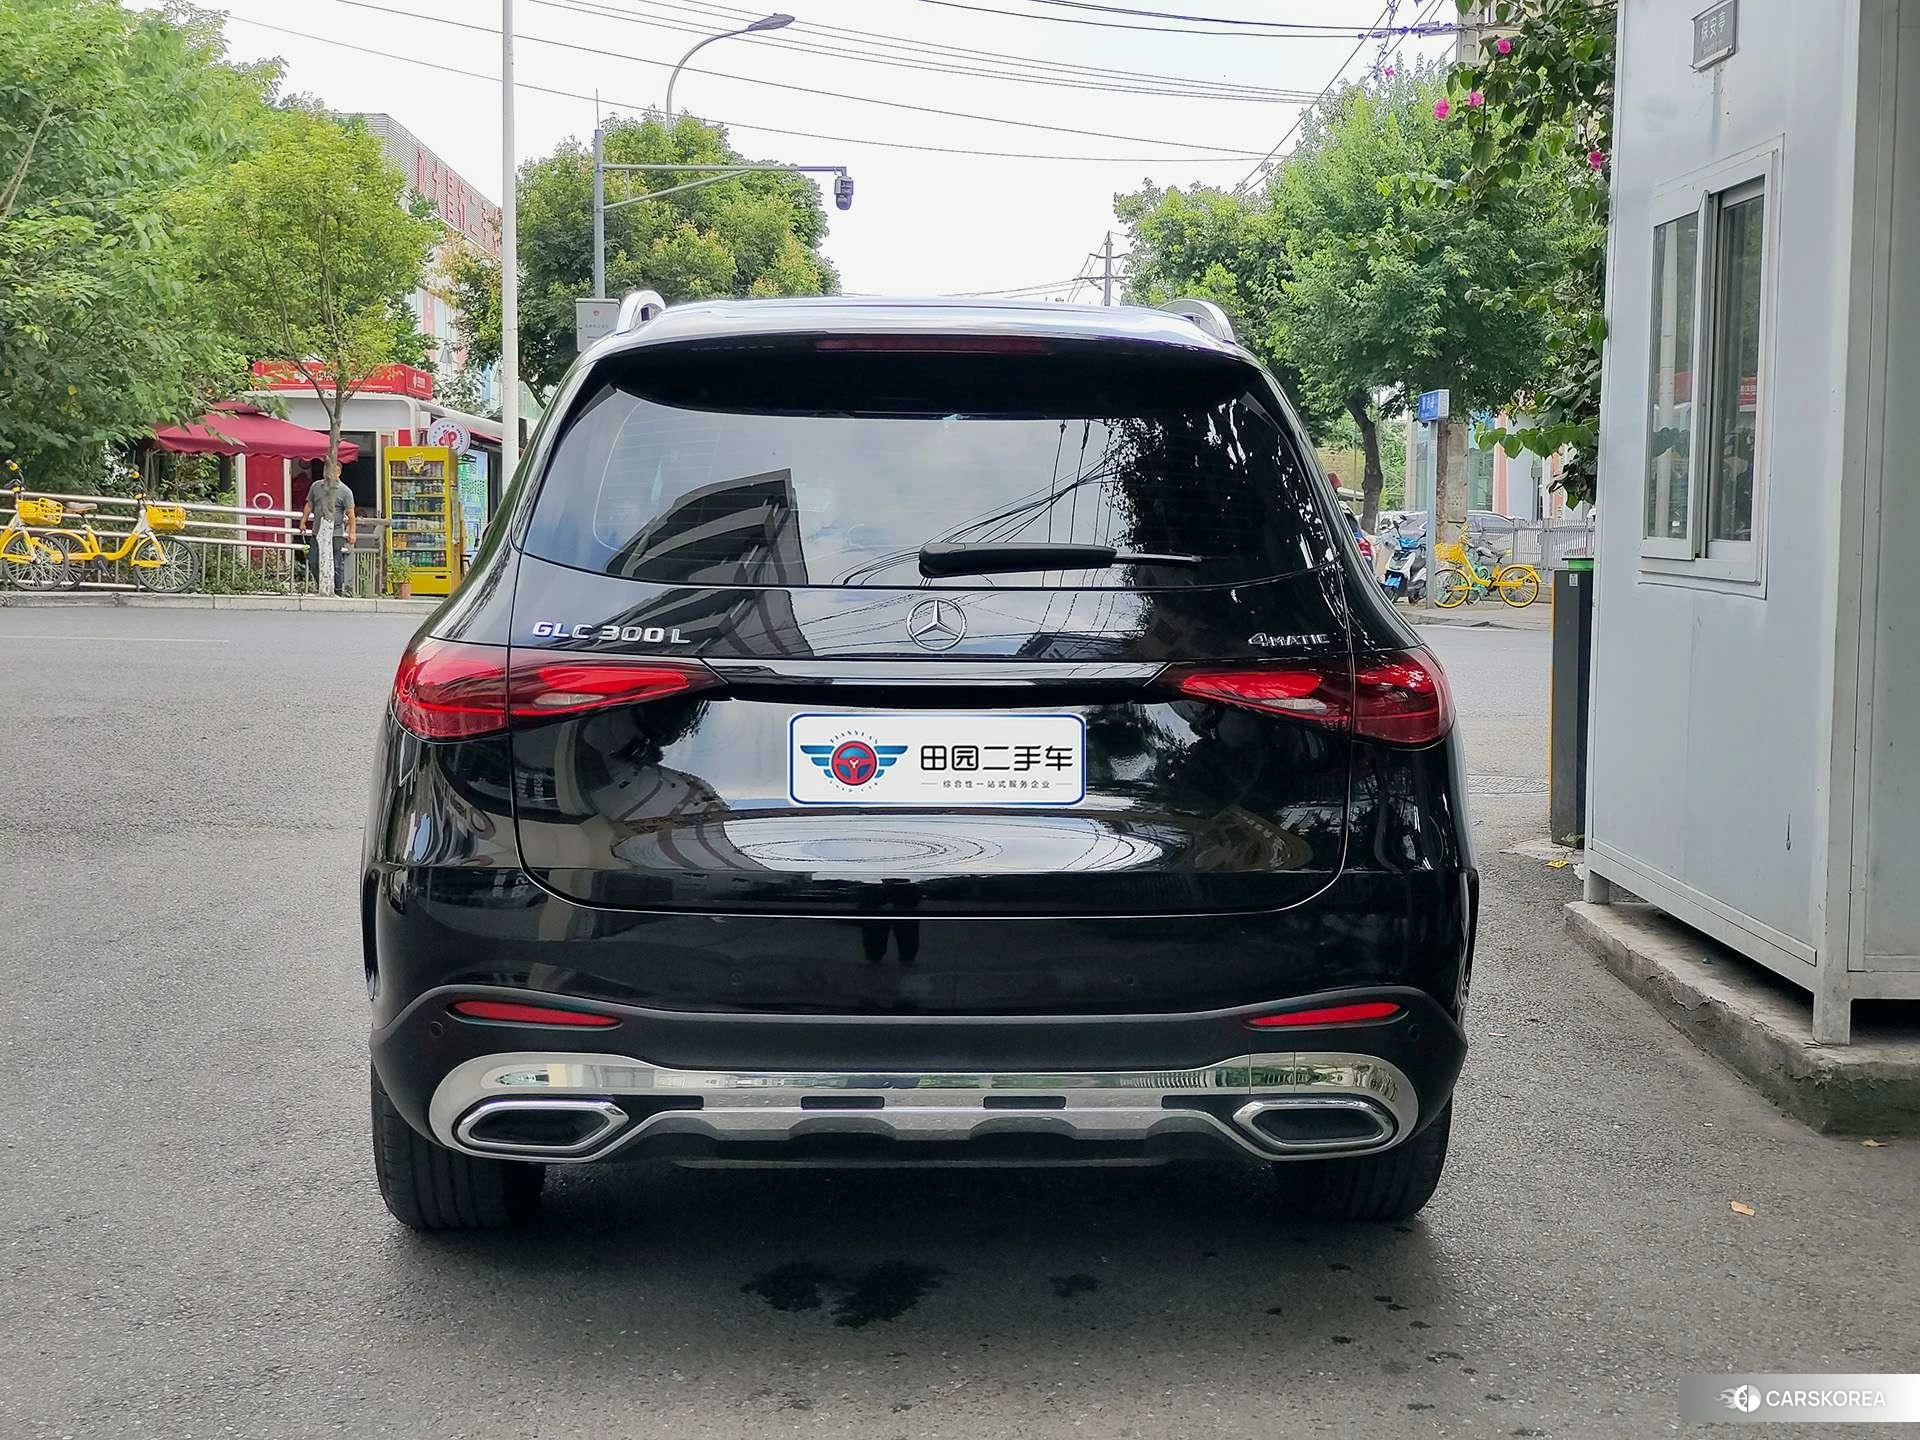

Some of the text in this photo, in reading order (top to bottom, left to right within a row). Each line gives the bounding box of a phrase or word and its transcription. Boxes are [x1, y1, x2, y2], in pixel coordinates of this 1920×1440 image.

[1701, 11, 1726, 41] 保安亭
[532, 621, 691, 644] GLC 300 L
[1248, 632, 1330, 647] 4MATIC
[920, 745, 1074, 772] 田园二手车
[943, 780, 1051, 789] 综合性一站式服务企业
